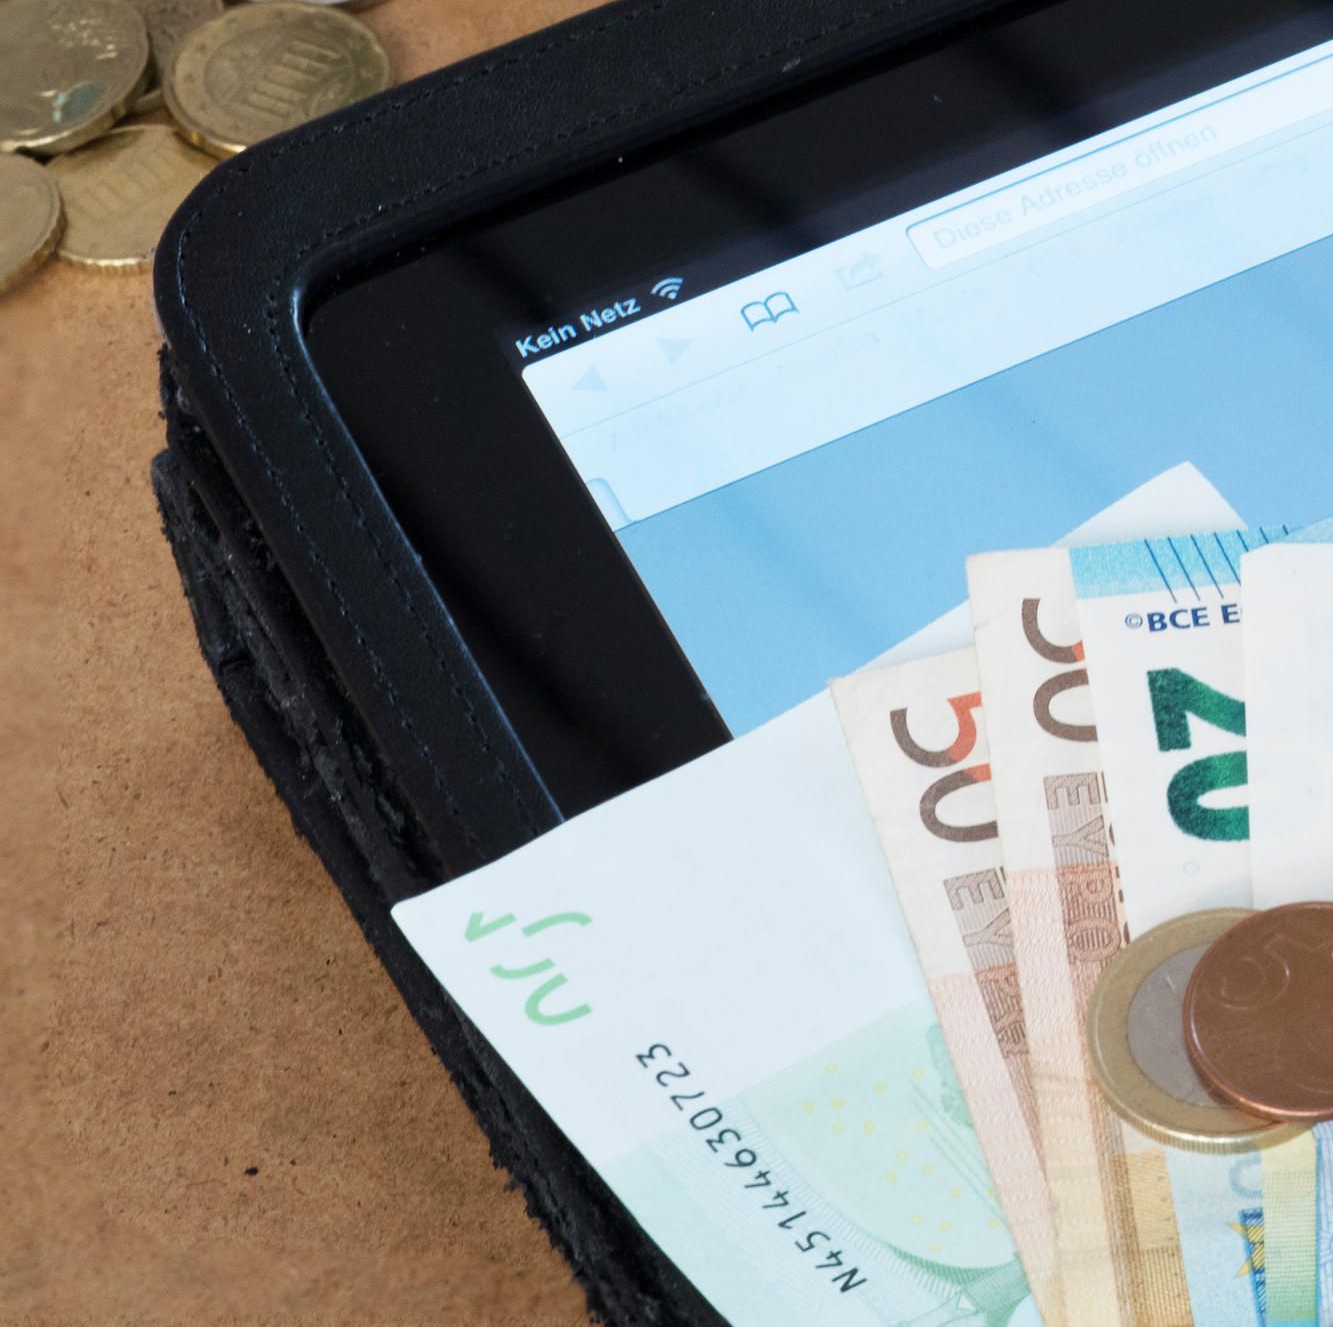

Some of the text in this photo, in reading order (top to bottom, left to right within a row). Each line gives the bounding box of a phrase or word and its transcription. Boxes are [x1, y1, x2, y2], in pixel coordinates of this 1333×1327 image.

[932, 123, 1218, 251] Diese Adresse öffnen
[515, 297, 641, 358] Kein Netz
[890, 691, 999, 843] 50
[636, 1042, 868, 1295] N45144630723
